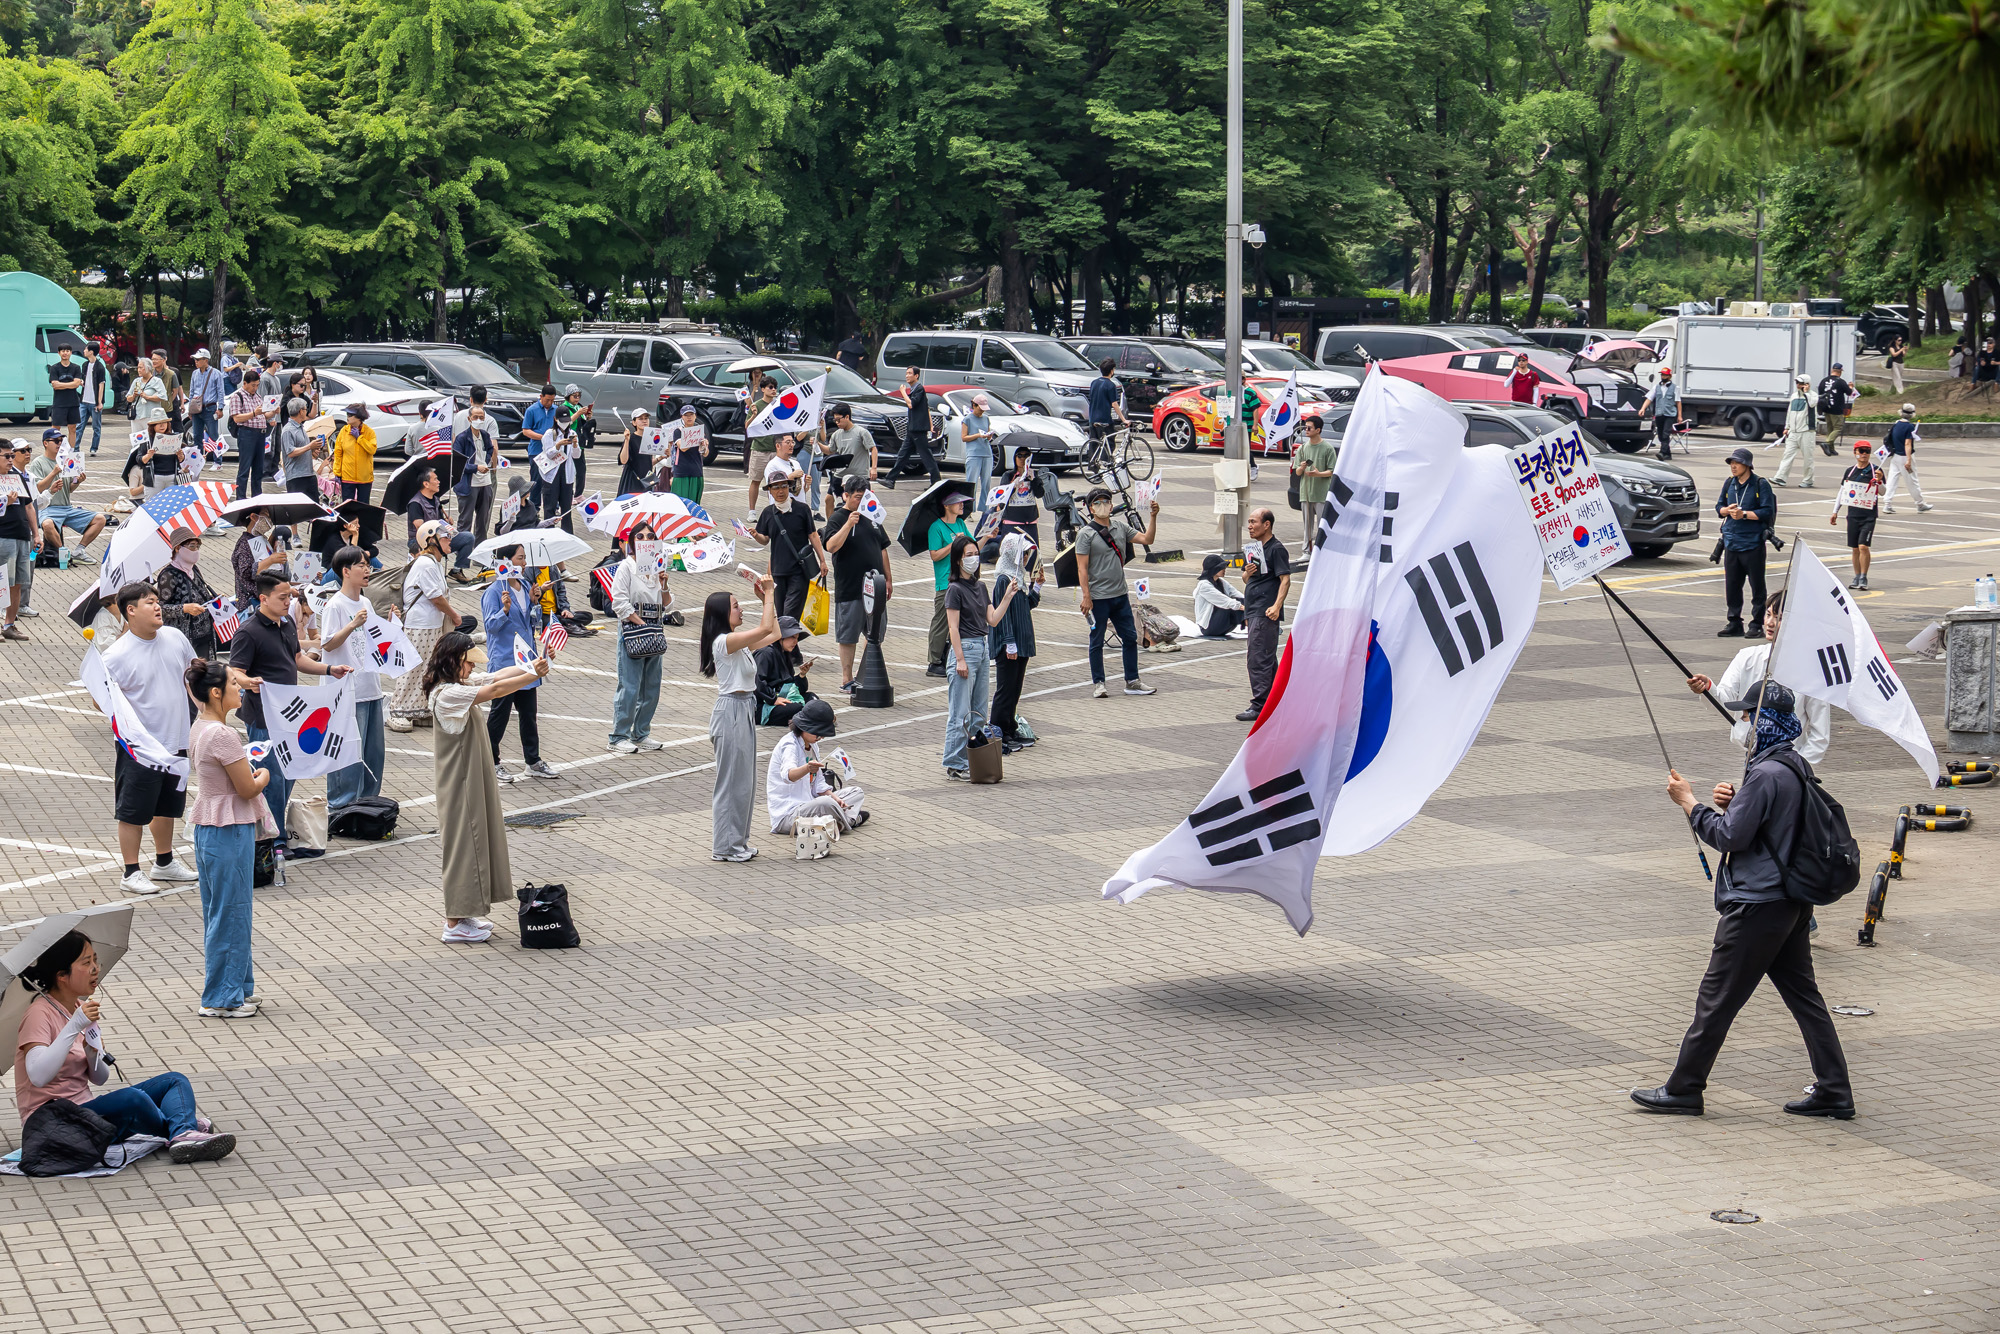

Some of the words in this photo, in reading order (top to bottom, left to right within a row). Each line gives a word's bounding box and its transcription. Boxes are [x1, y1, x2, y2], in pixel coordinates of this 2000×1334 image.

[1514, 430, 1590, 493] 부정선거
[1538, 512, 1573, 543] 부정선거
[1575, 498, 1605, 520] 재선거
[1547, 544, 1579, 571] 당일투표
[1592, 522, 1618, 545] 수개표
[1573, 558, 1588, 571] STOP
[1589, 552, 1599, 564] THE
[527, 922, 562, 931] KANGOL
